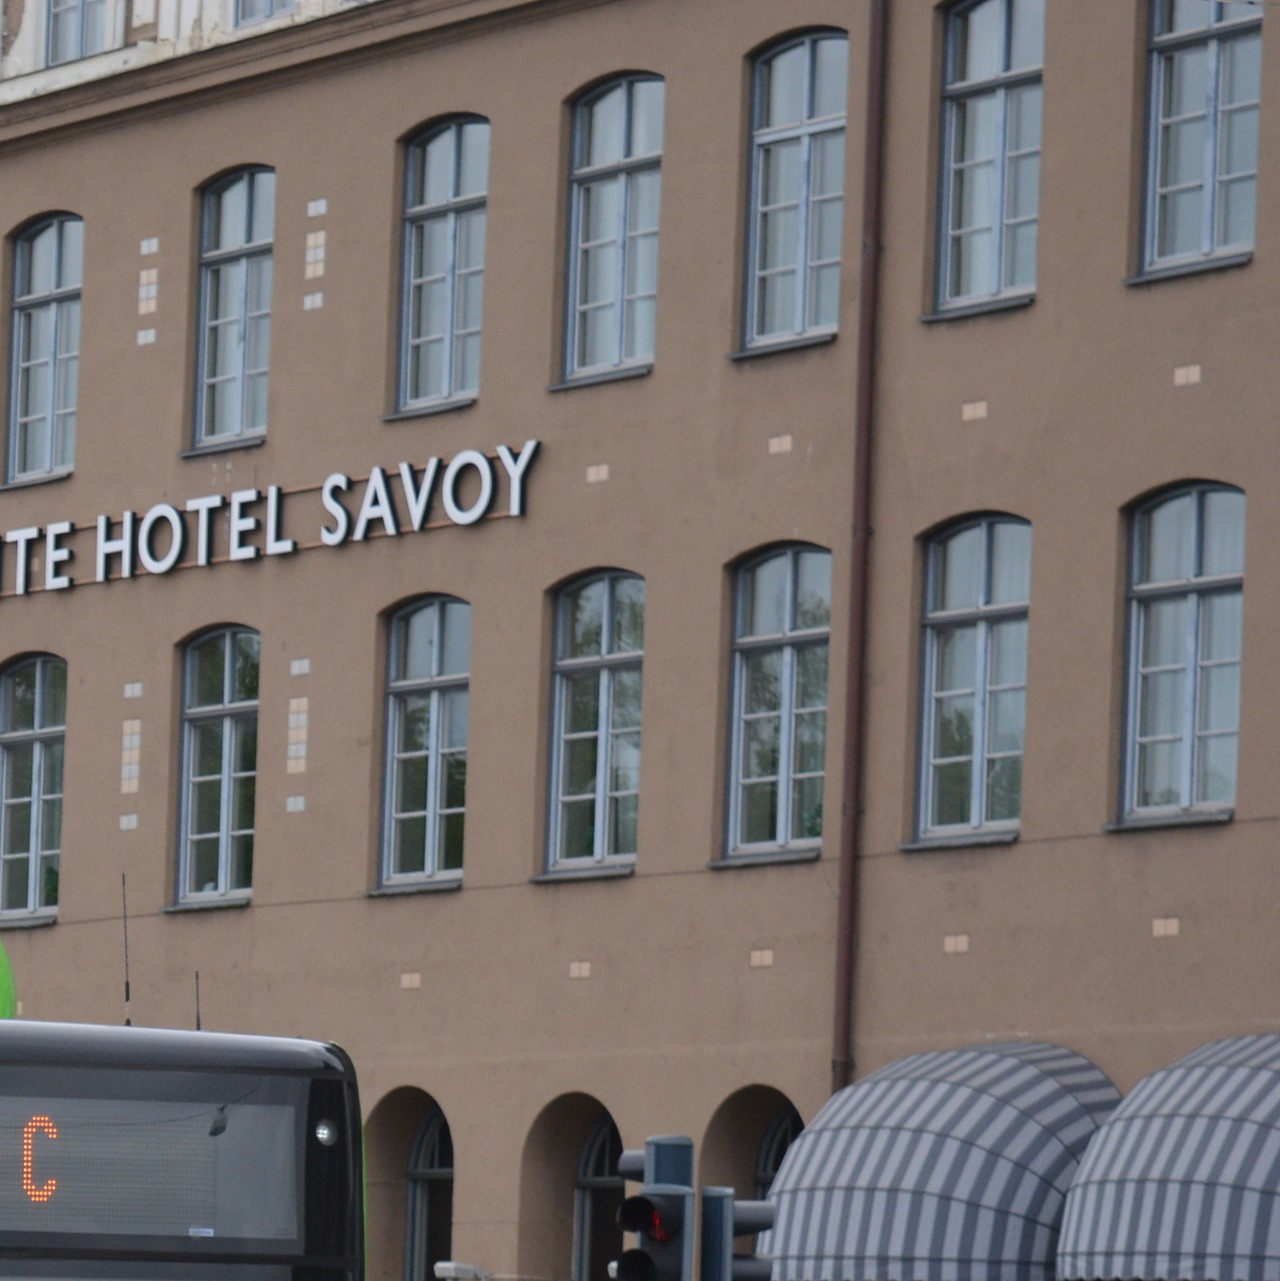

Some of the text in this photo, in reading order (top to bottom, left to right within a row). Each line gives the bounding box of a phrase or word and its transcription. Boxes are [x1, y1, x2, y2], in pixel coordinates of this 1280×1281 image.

[95, 484, 297, 583] HOTEL
[320, 438, 542, 548] SAVOY
[22, 1115, 59, 1204] C
